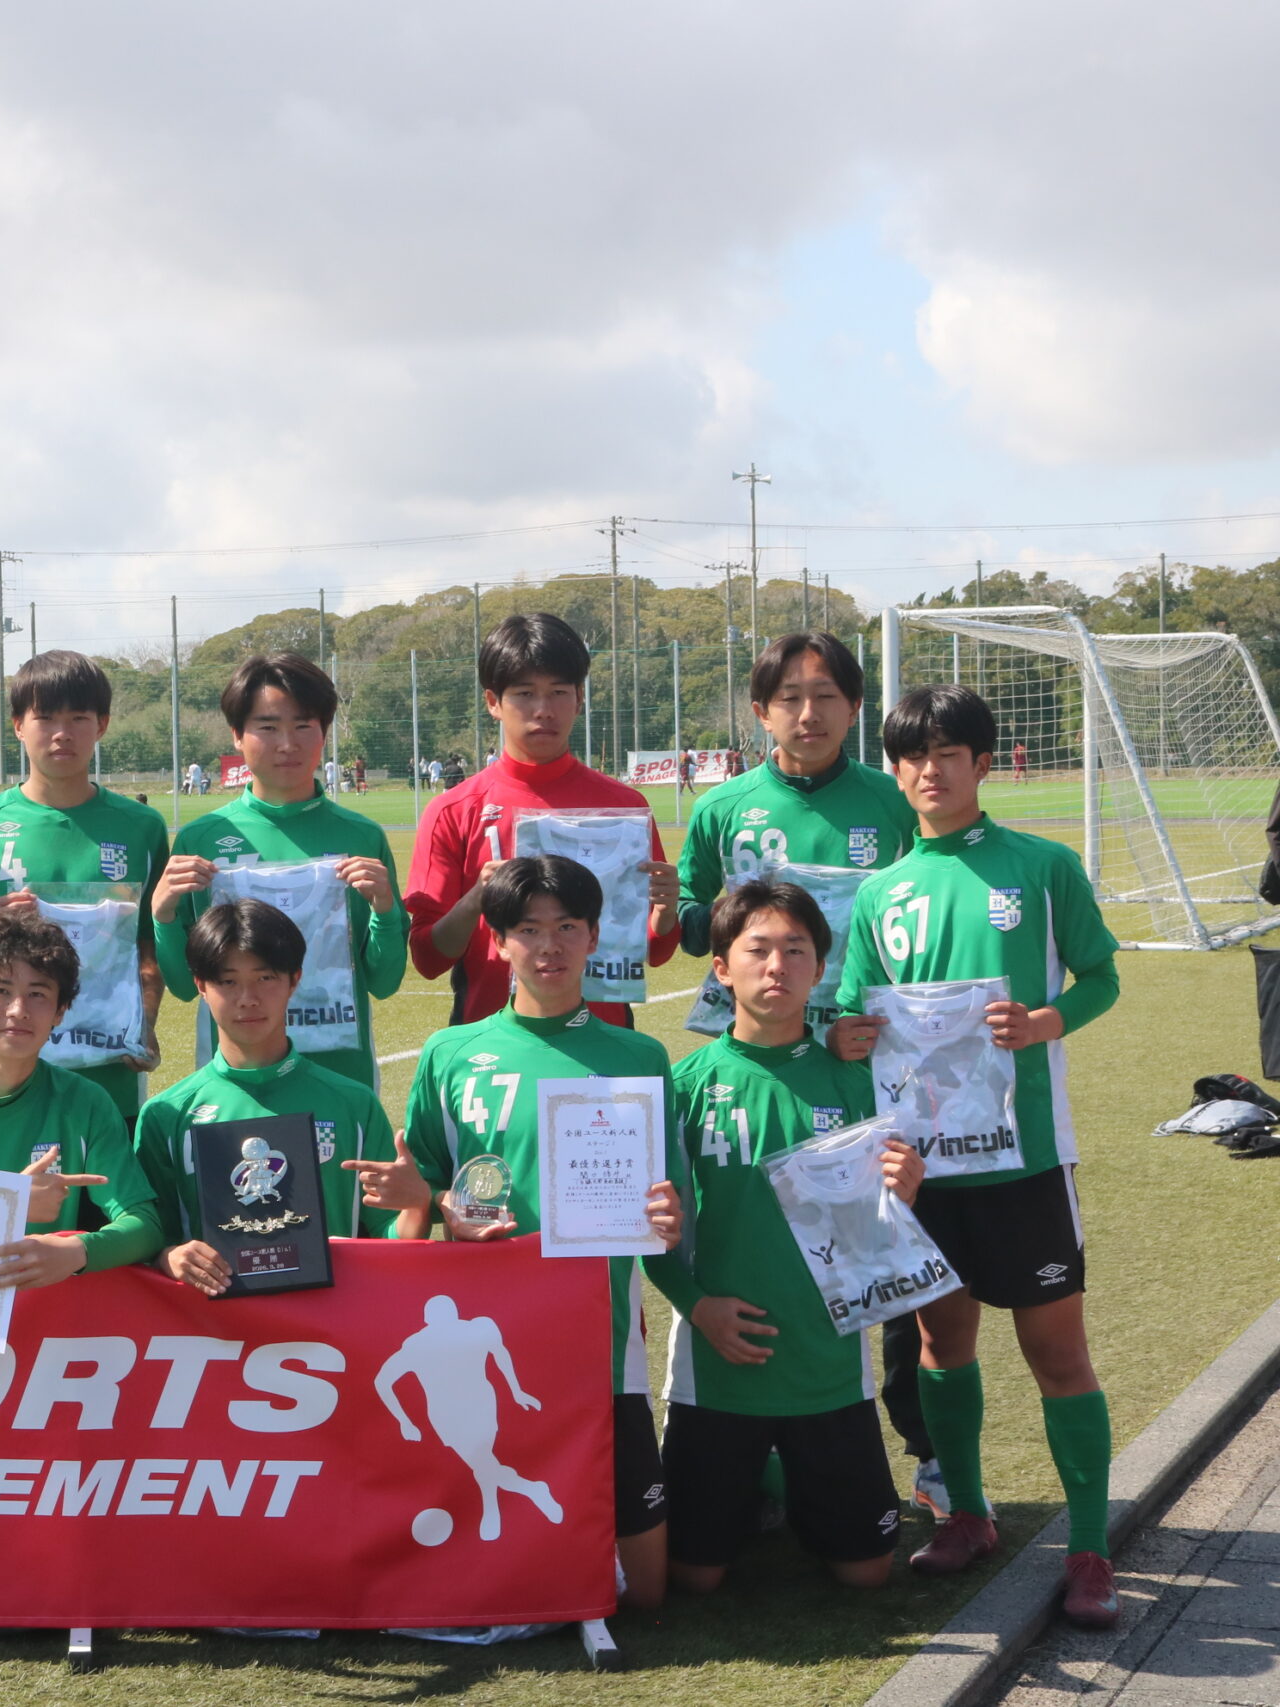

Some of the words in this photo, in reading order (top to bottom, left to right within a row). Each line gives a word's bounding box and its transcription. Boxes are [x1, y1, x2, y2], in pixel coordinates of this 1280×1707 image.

[732, 828, 789, 874] 68
[882, 895, 930, 961] 67
[461, 1073, 521, 1134] 47
[701, 1108, 752, 1167] 41
[1041, 1276, 1066, 1287] umbro
